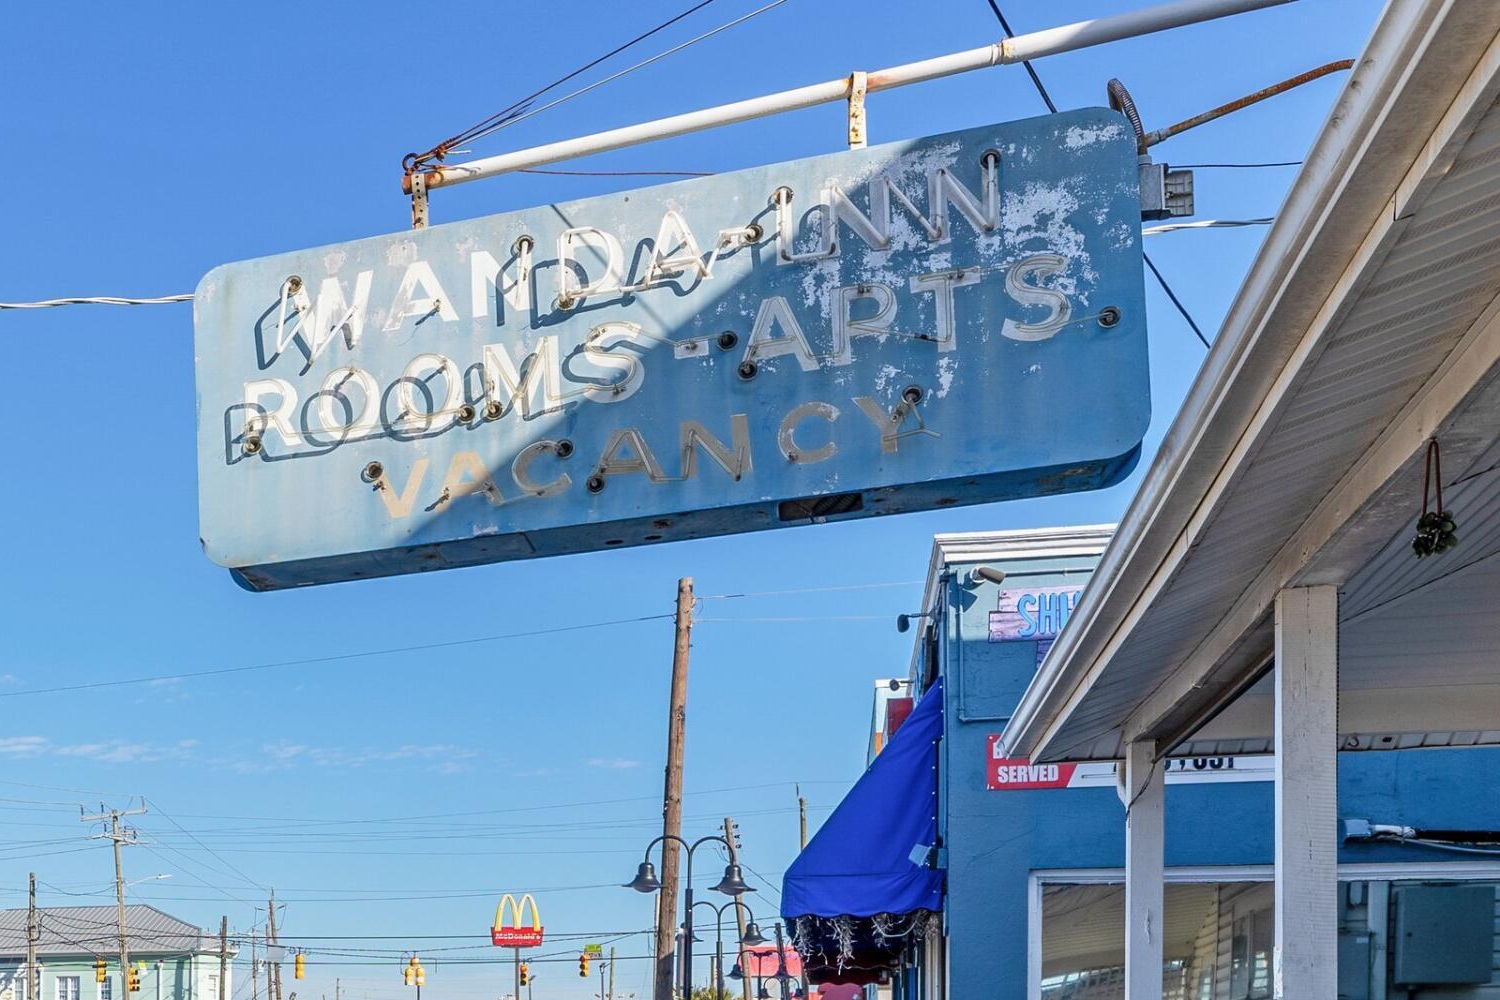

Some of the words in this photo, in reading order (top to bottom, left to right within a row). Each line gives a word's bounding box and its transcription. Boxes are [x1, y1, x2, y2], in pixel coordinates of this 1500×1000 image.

[375, 396, 922, 518] VACANCY
[997, 765, 1059, 783] SERVED
[495, 932, 541, 940] McDonald's
